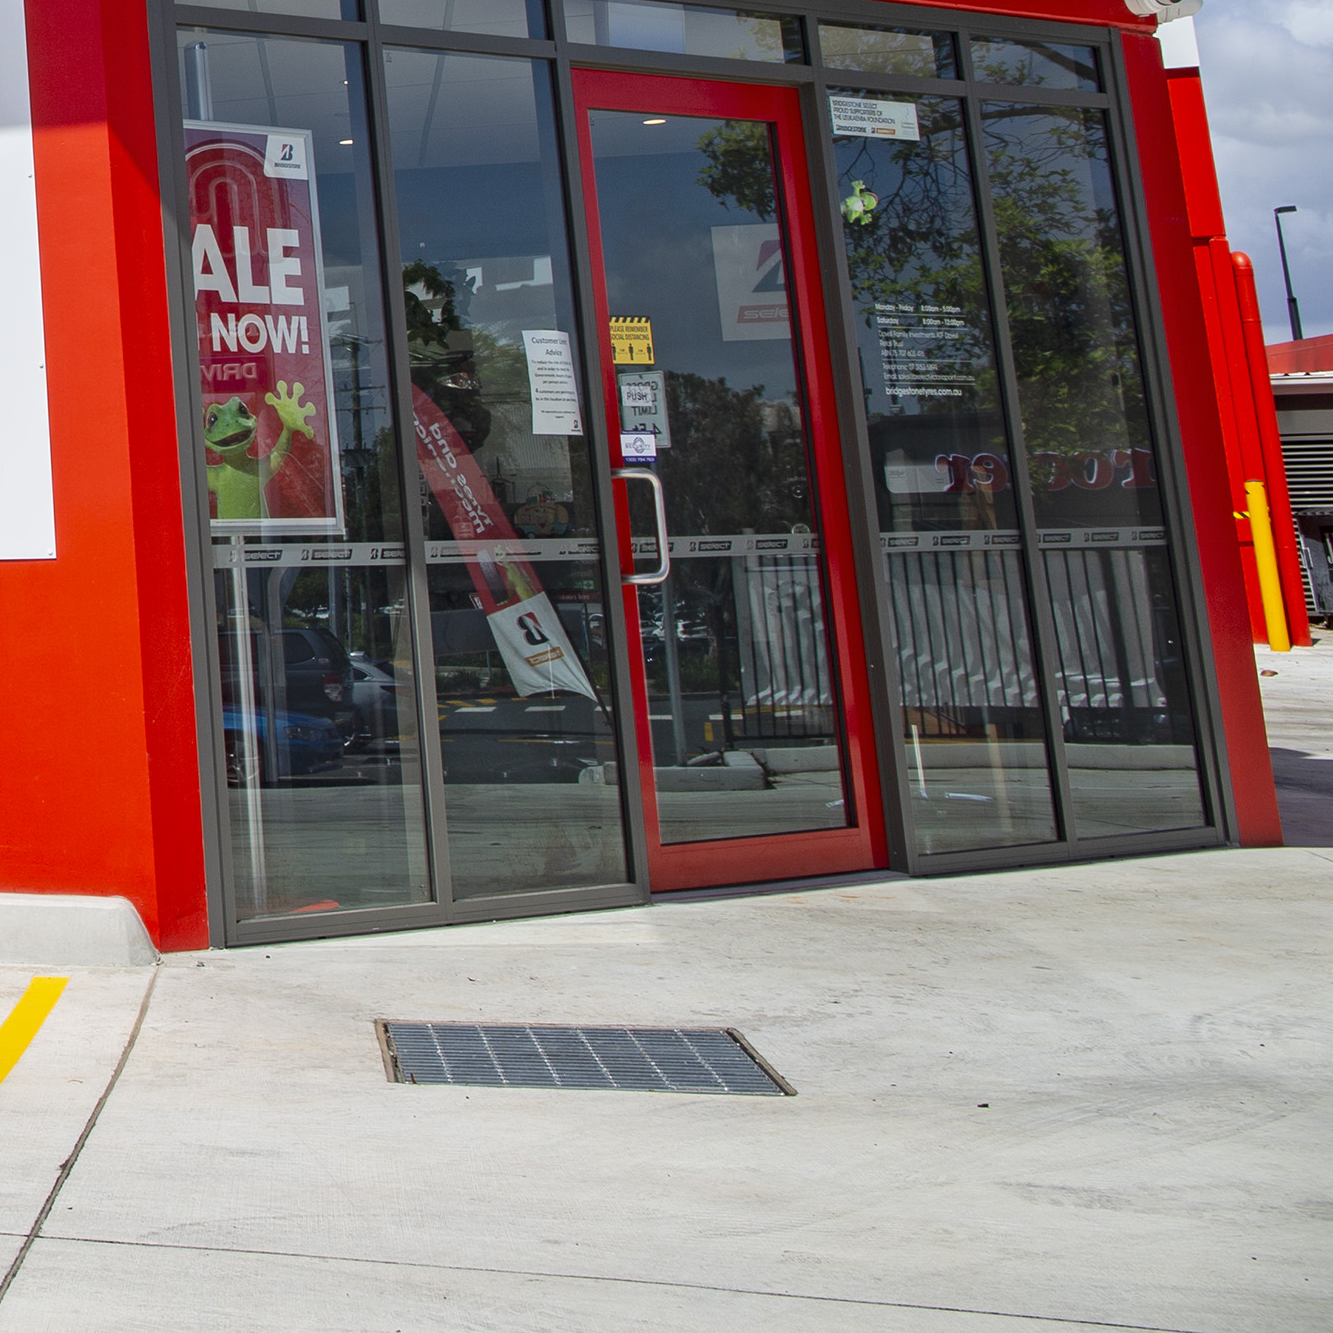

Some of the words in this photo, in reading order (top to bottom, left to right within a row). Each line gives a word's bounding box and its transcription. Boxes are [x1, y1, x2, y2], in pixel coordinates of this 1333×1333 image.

[210, 312, 310, 354] NOW!
[545, 348, 563, 356] Advice
[626, 392, 647, 401] PUSH
